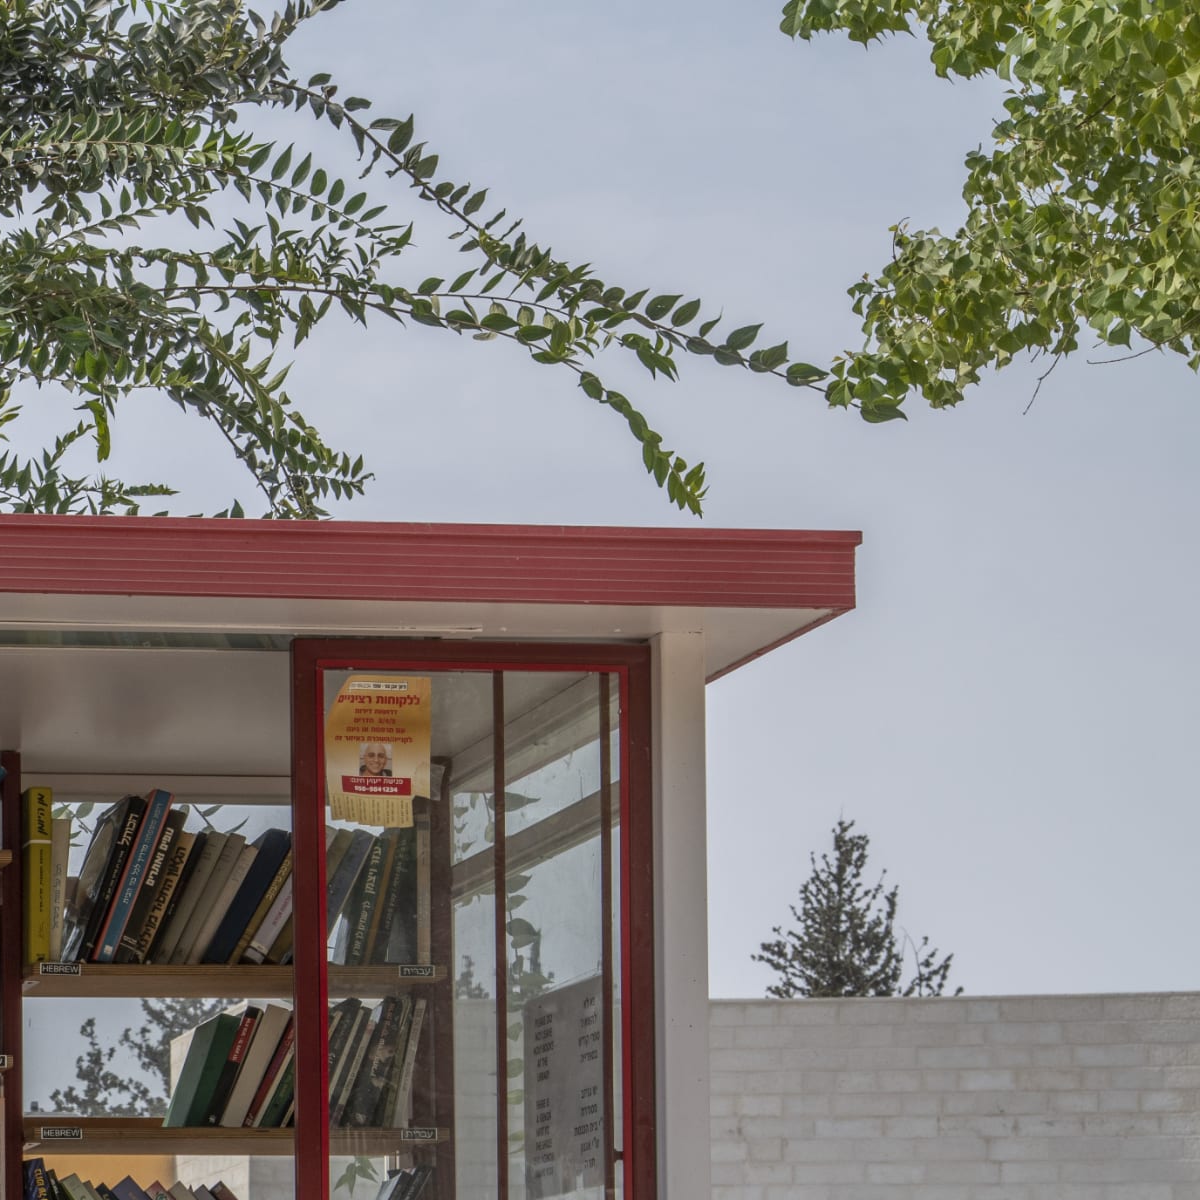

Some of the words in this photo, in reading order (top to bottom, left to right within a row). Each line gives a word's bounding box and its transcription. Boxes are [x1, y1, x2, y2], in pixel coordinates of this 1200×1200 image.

[338, 694, 372, 704] רציניים
[376, 694, 420, 707] ללקוחות
[37, 793, 47, 808] מן
[37, 809, 48, 835] היומן
[117, 813, 140, 846] הכותל
[167, 847, 187, 876] הגאון
[152, 878, 174, 911] החסיד
[42, 964, 78, 974] HEBREW
[403, 967, 433, 976] עברית
[43, 1129, 79, 1138] HEBREW
[403, 1130, 433, 1138] עברית
